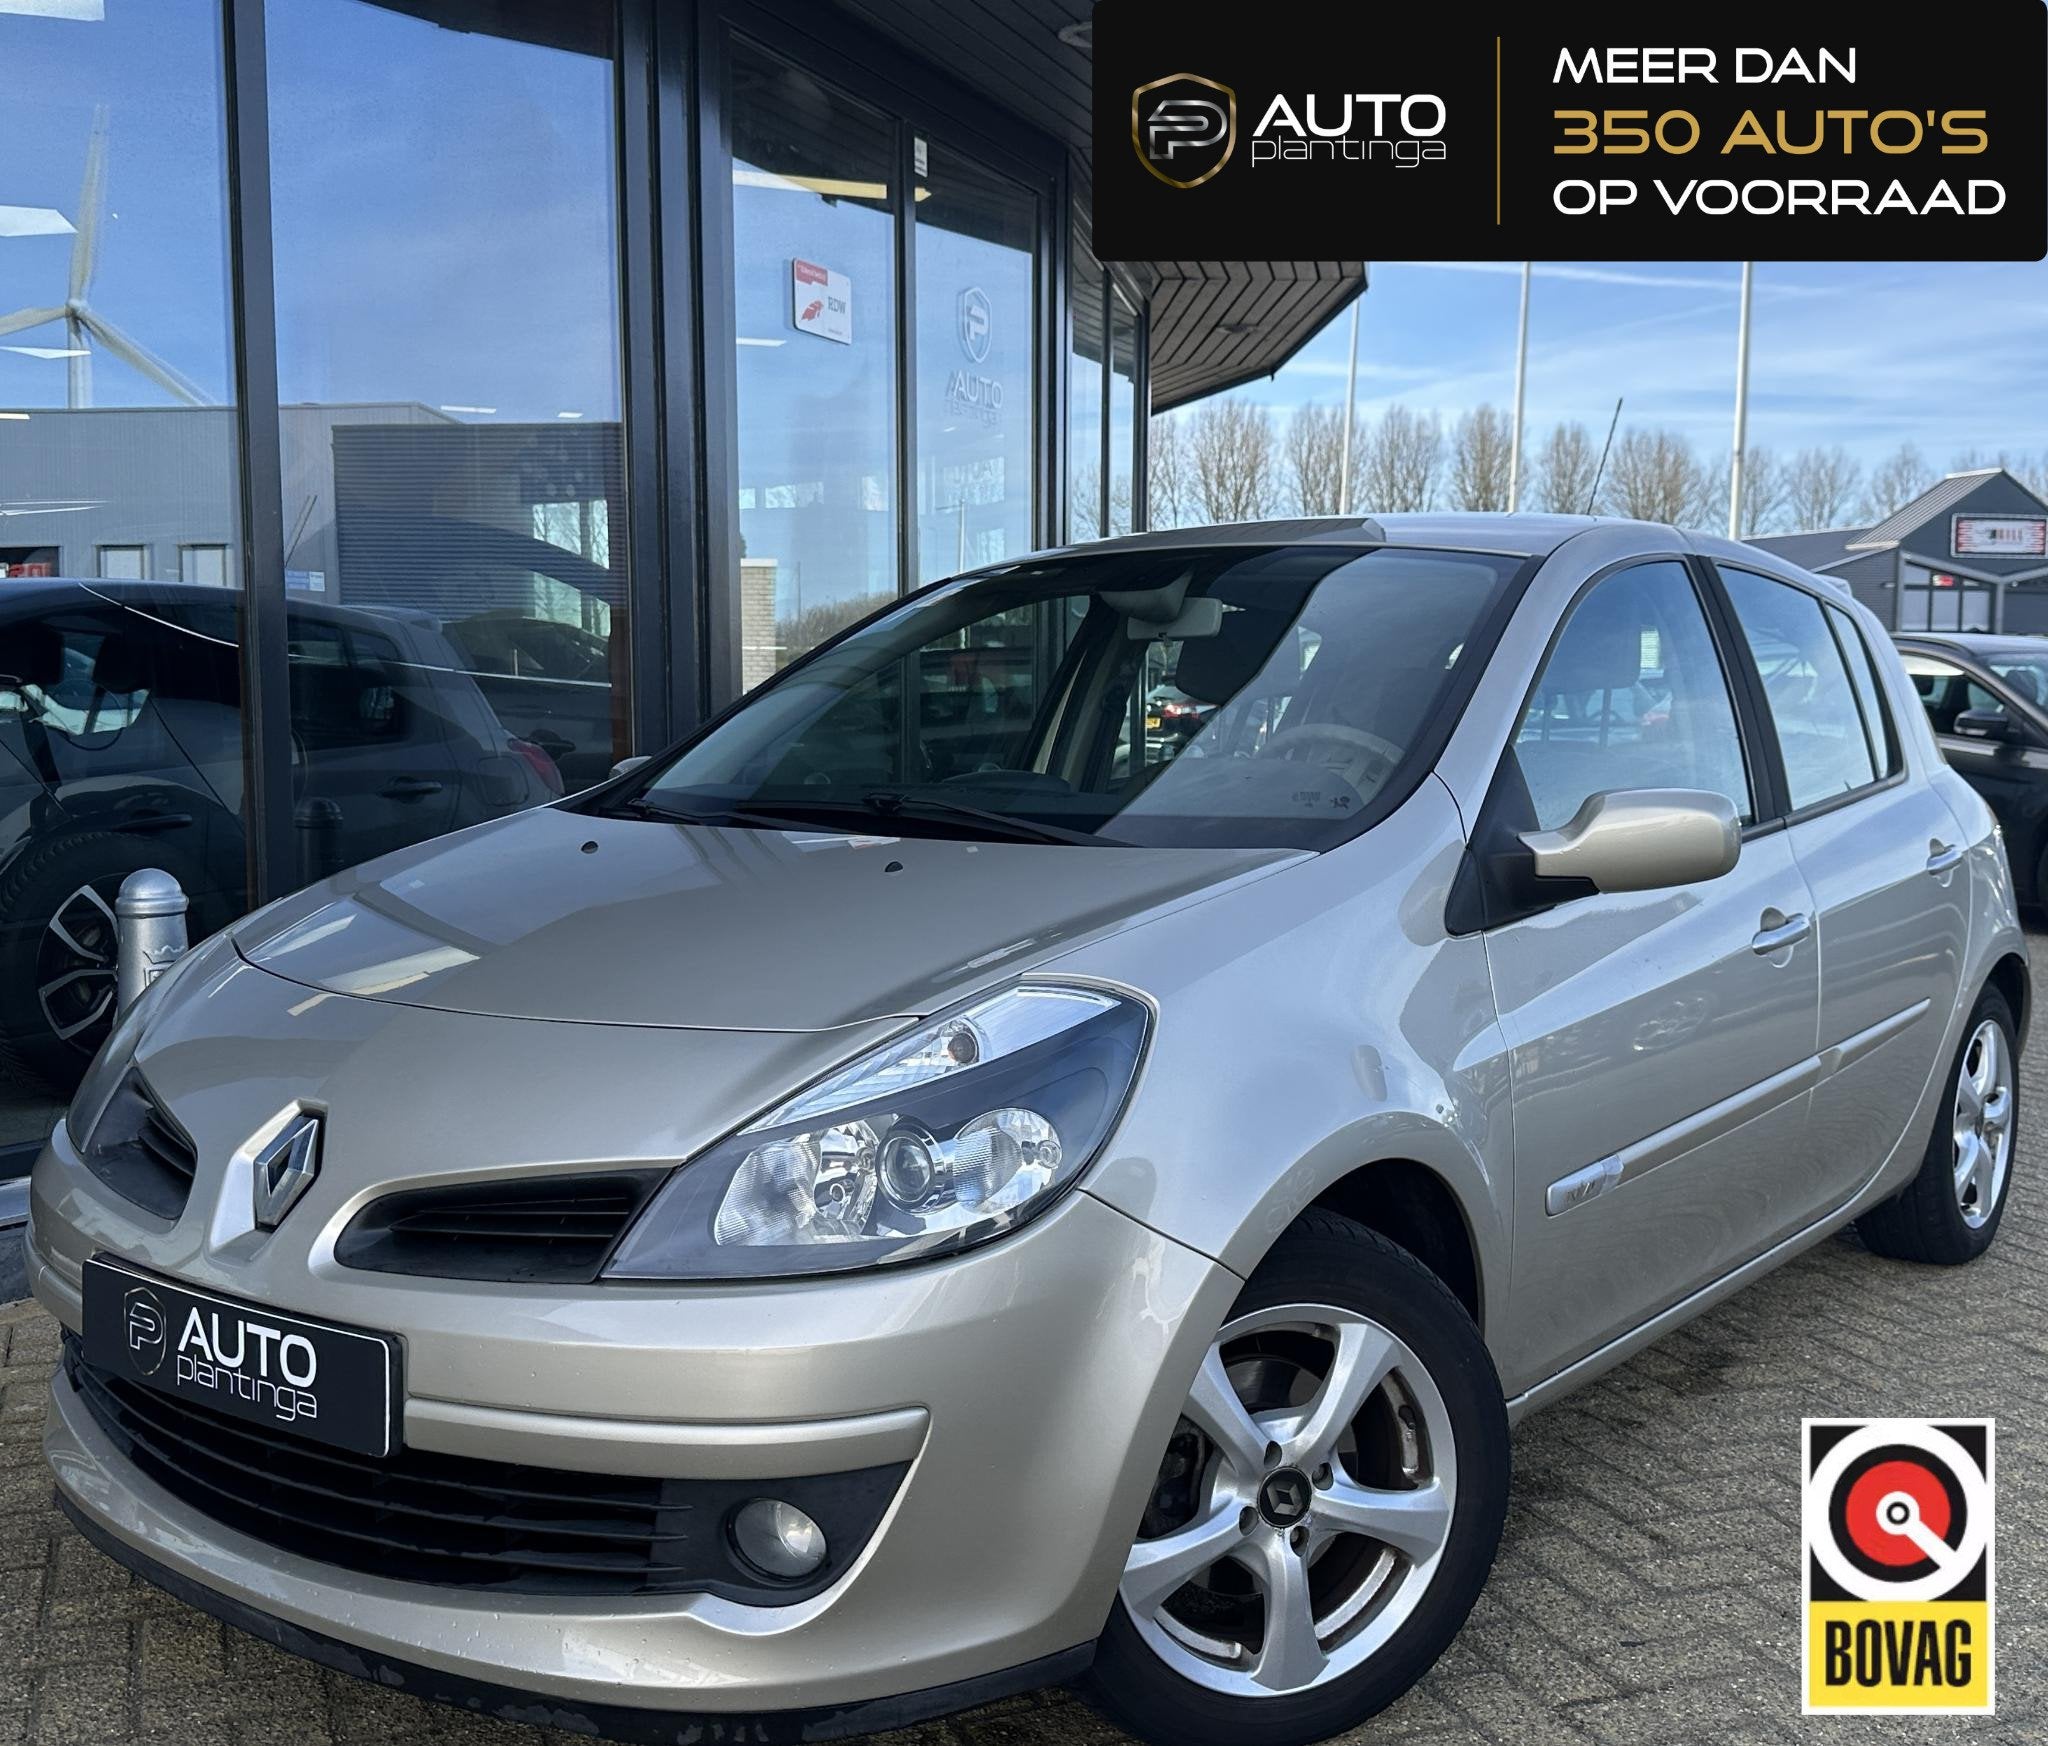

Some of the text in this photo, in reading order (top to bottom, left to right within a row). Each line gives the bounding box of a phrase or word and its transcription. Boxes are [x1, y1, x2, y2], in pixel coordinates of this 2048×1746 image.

[953, 370, 1003, 409] AUTO
[177, 1306, 317, 1388] AUTO
[176, 1353, 317, 1421] plantinga
